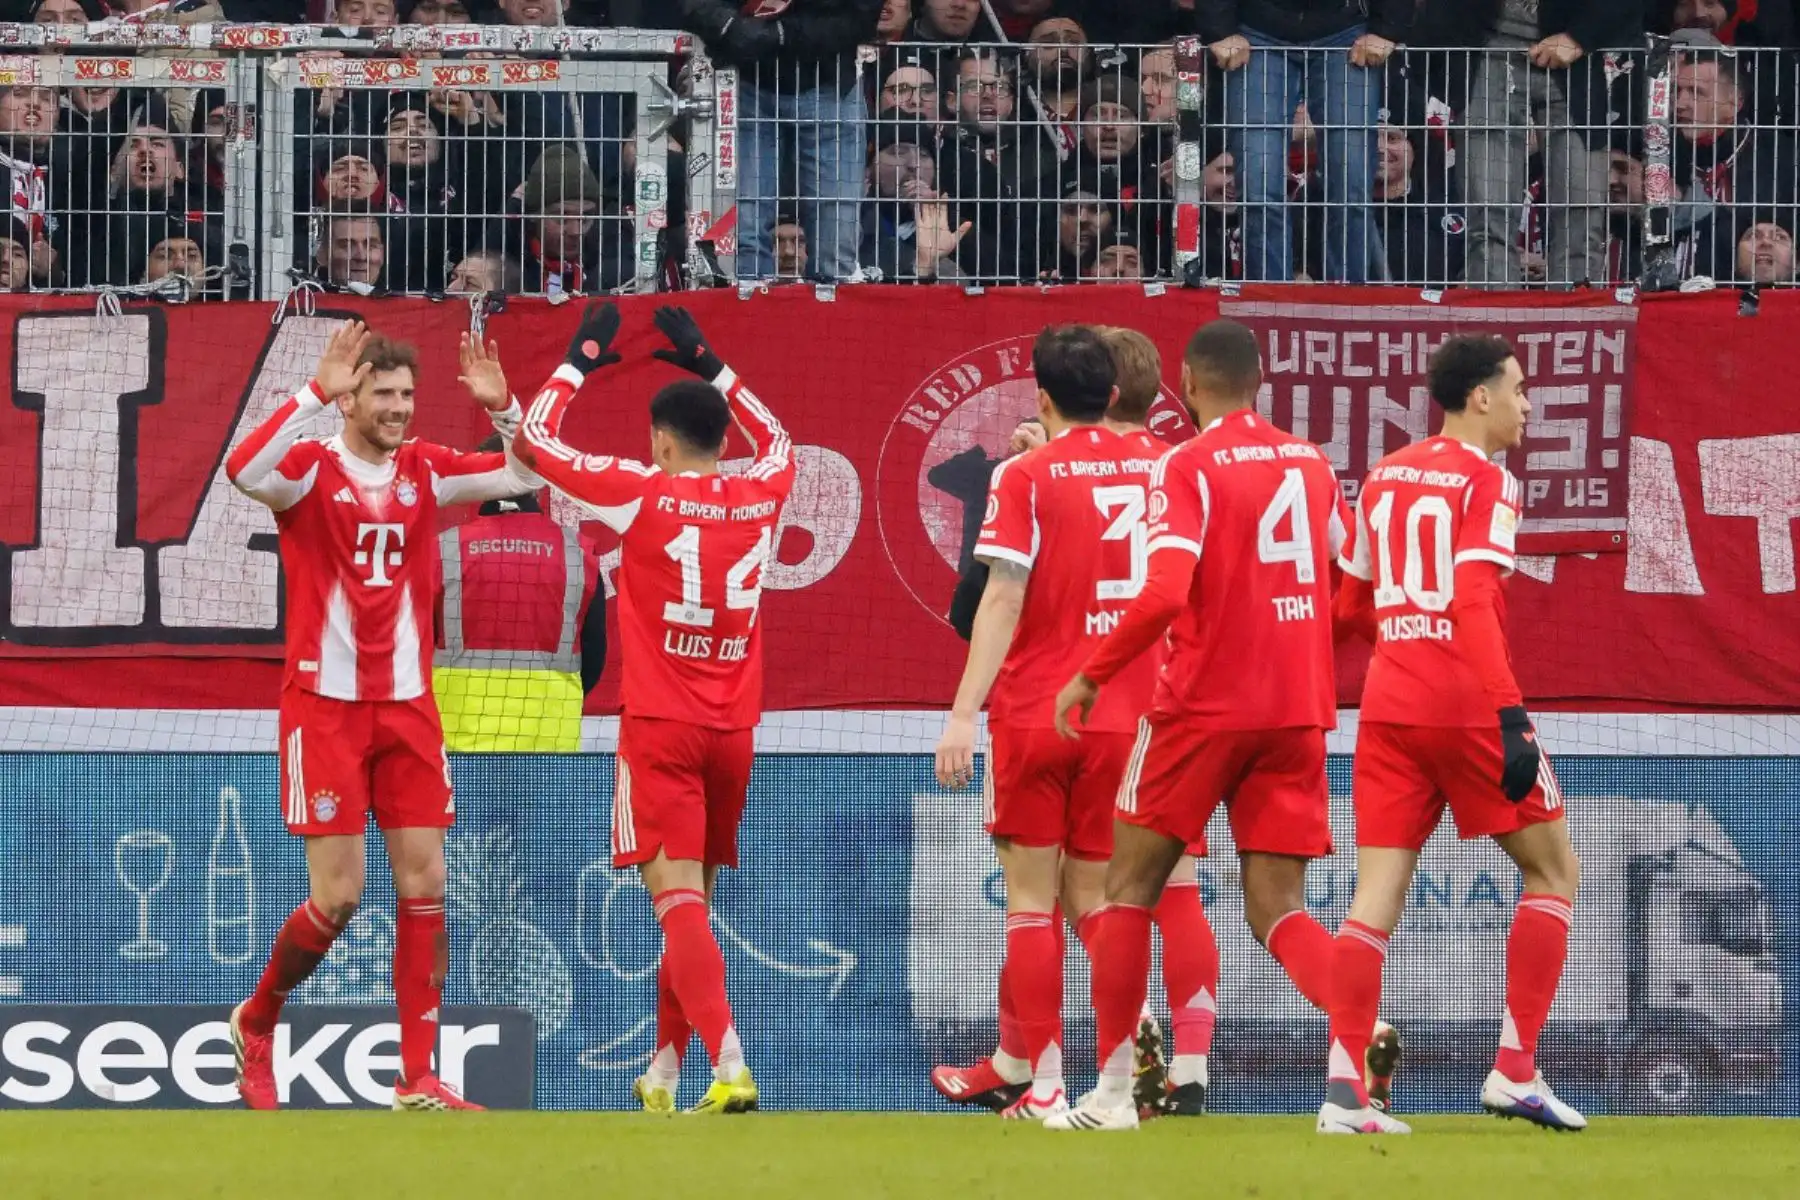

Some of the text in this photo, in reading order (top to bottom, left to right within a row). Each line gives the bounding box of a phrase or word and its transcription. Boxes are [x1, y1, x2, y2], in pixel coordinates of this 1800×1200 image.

[75, 60, 132, 80] WOS
[170, 60, 226, 80] WOS
[433, 65, 489, 85] WOS
[503, 61, 559, 83] WOS
[901, 364, 982, 434] RED
[1049, 461, 1068, 478] FC
[1213, 449, 1232, 466] FC
[658, 495, 676, 513] FC
[679, 500, 727, 520] BAYERN
[1258, 467, 1315, 584] 4
[468, 539, 553, 558] SECURITY
[1092, 485, 1149, 600] 3
[1369, 491, 1454, 611] 10
[662, 524, 771, 628] 14
[1271, 594, 1315, 622] TAH
[664, 629, 713, 659] LUIS
[0, 1020, 500, 1104] seeker
